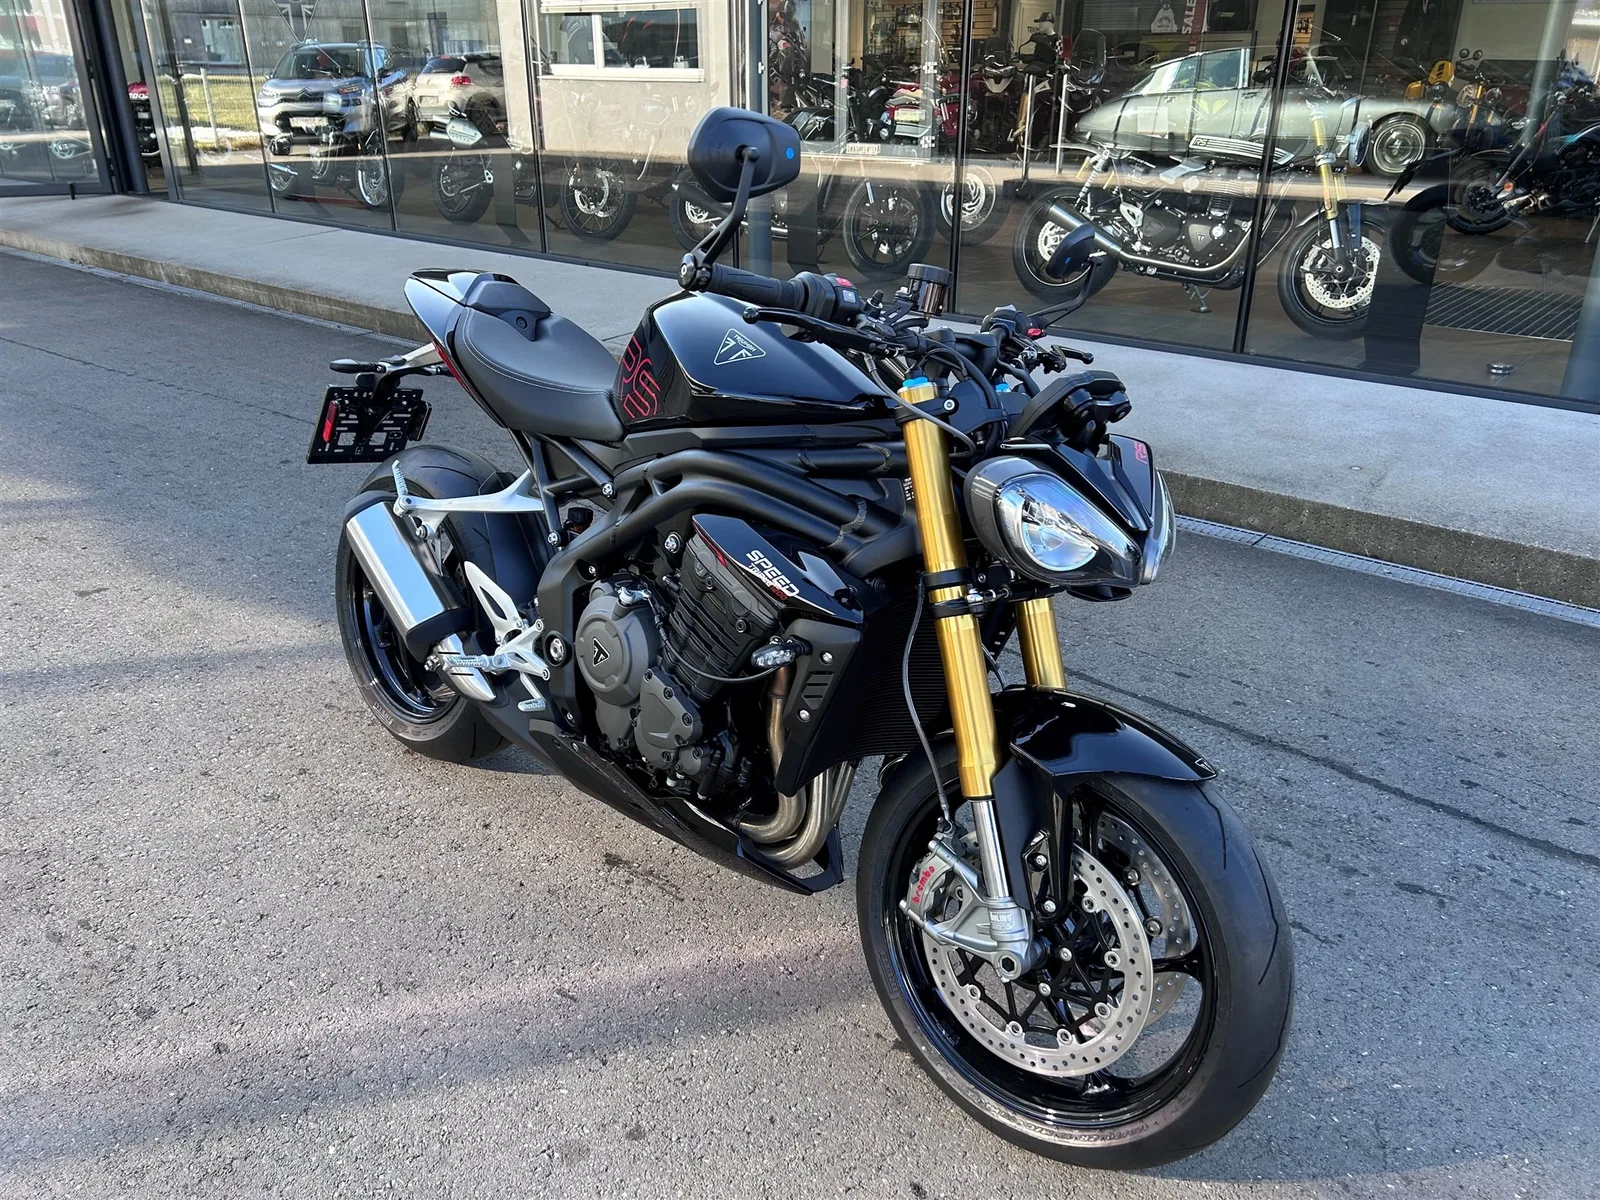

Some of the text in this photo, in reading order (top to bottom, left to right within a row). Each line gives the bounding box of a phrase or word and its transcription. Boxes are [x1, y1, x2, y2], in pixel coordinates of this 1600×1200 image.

[1181, 0, 1197, 34] SALE
[1134, 441, 1147, 465] RS
[746, 549, 800, 597] SPEED
[912, 865, 935, 904] brembo
